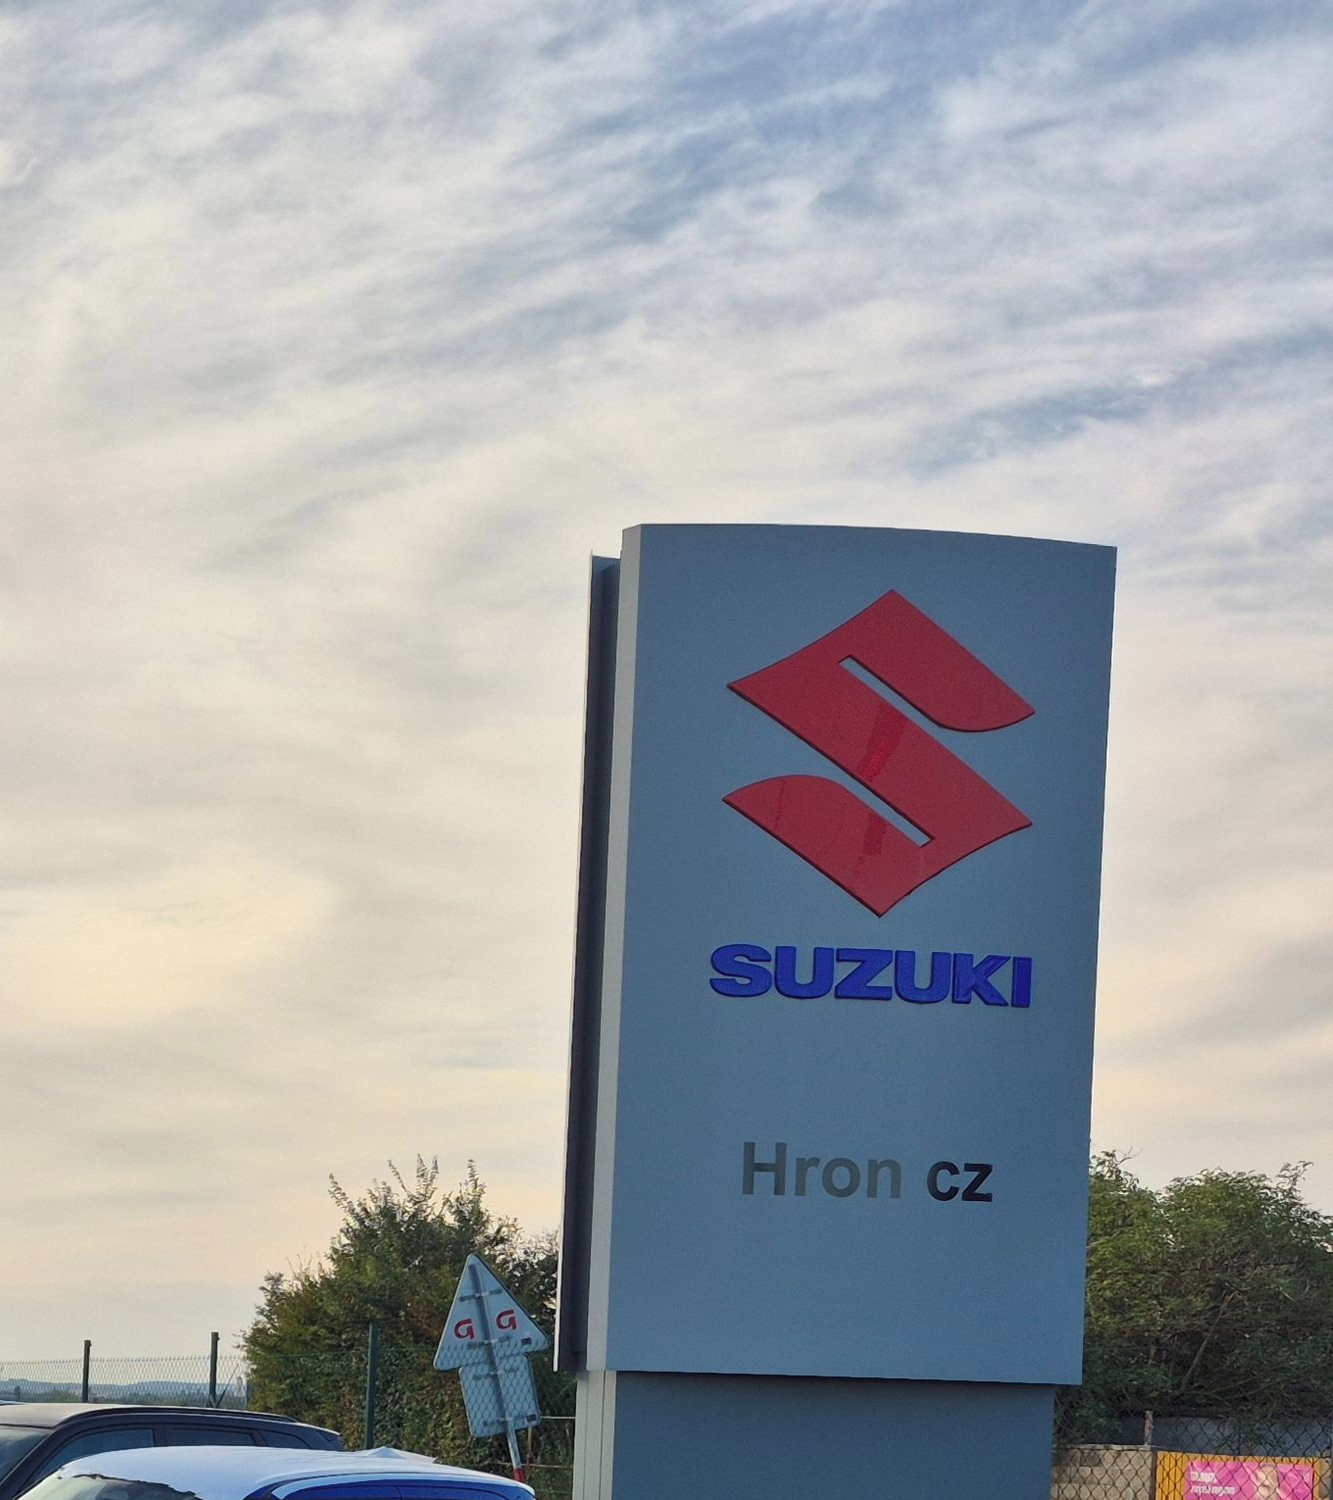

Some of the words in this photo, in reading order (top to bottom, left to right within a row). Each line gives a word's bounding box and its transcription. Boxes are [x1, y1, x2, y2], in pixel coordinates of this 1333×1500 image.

[709, 943, 1033, 1008] SUZUKI
[742, 1141, 902, 1199] Hron
[926, 1161, 994, 1202] cz
